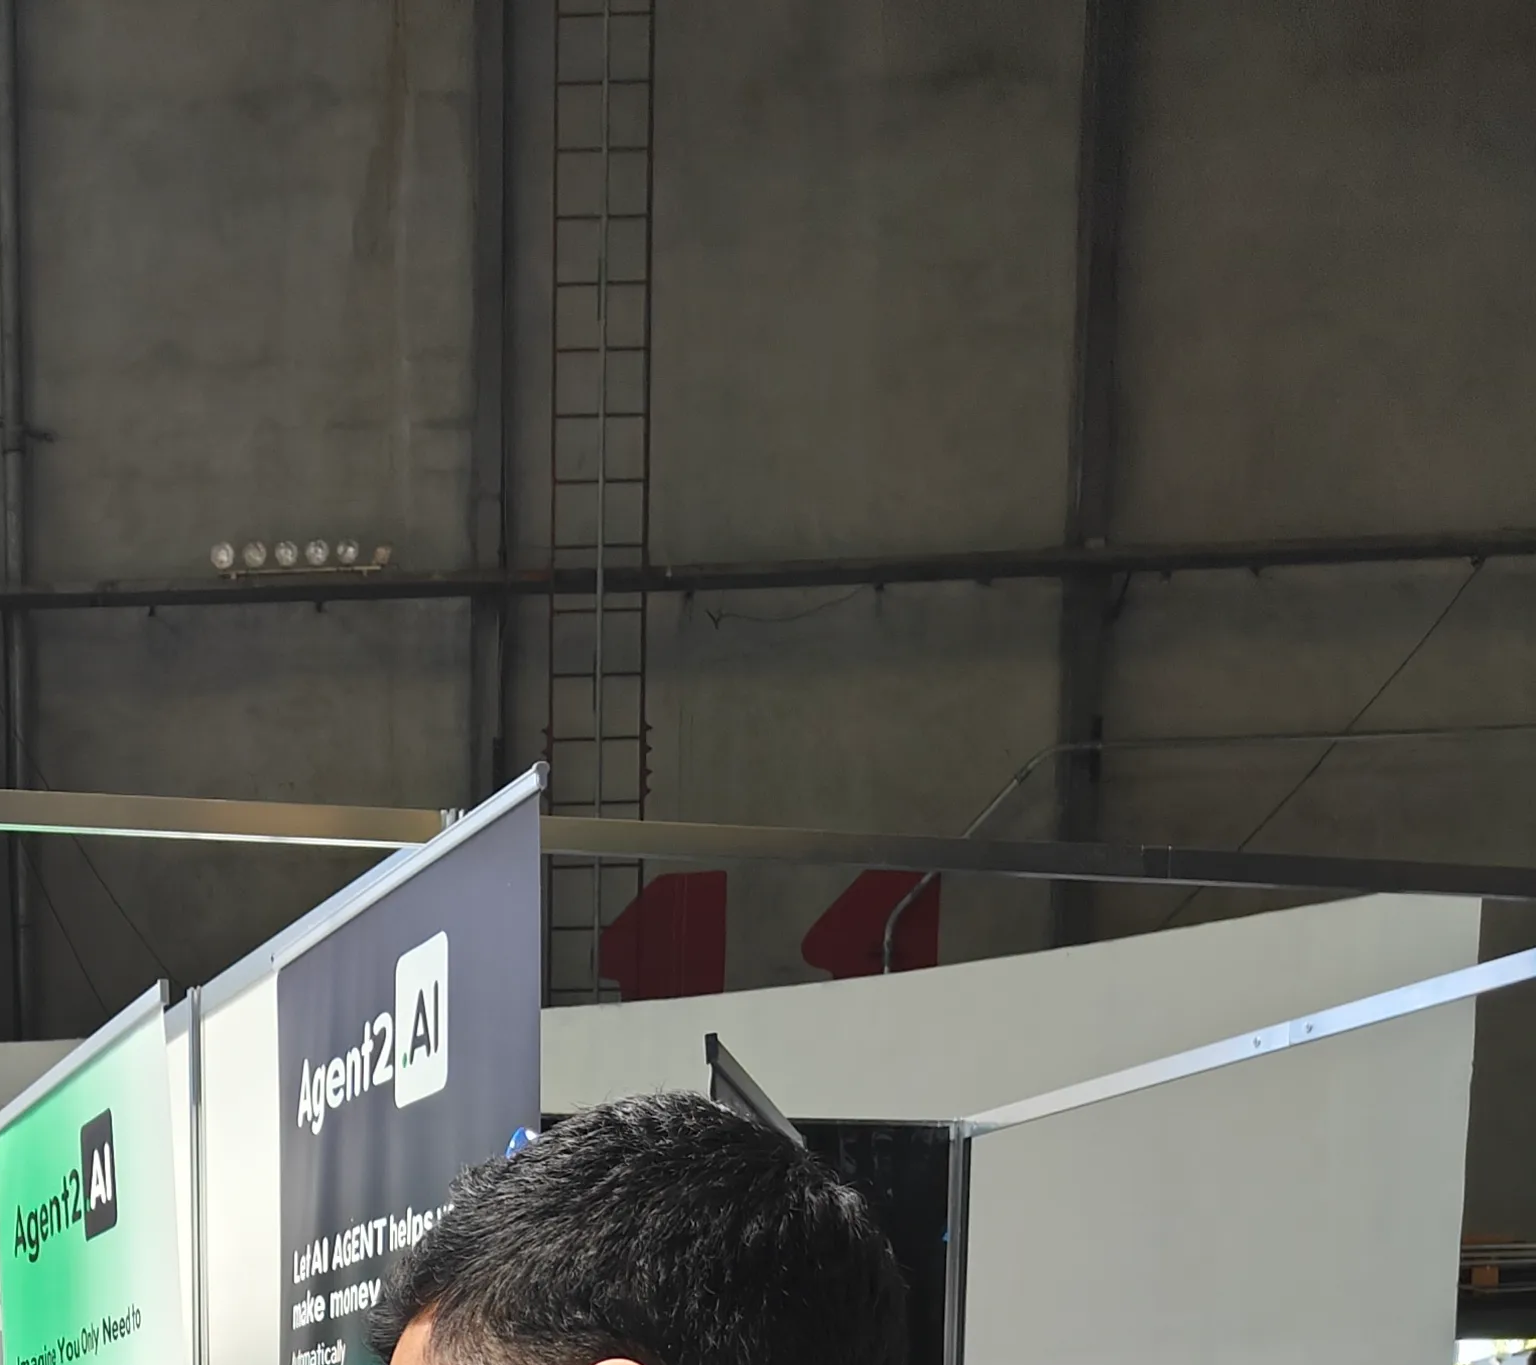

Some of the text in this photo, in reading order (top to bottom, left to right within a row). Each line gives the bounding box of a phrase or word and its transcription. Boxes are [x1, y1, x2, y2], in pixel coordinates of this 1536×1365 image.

[297, 1012, 395, 1135] Agent2
[14, 1168, 81, 1263] Agent2
[293, 1244, 311, 1285] Let
[311, 1236, 329, 1277] AI
[331, 1217, 387, 1271] AGENT
[57, 1336, 81, 1365] You
[102, 1306, 131, 1346] Need
[131, 1303, 142, 1331] to
[292, 1277, 382, 1331] make money
